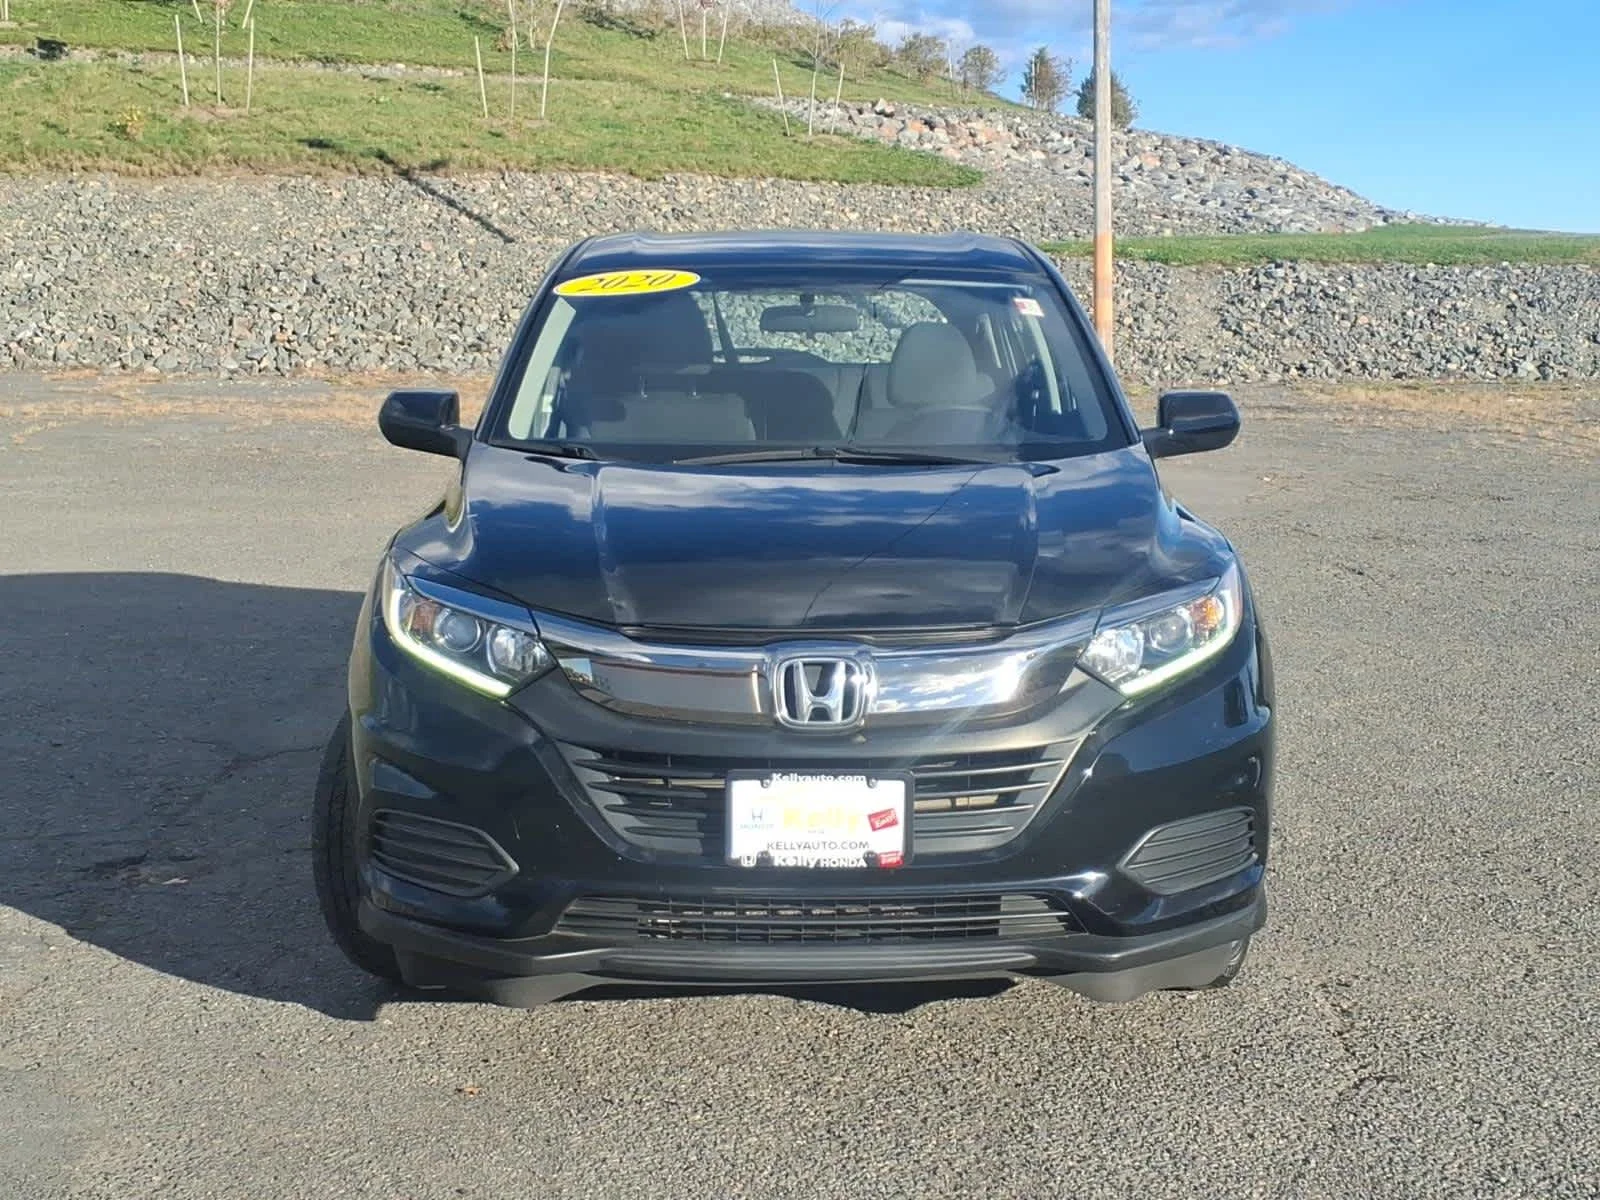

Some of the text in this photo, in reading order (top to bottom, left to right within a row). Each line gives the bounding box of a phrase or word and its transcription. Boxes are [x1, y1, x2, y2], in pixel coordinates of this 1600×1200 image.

[576, 274, 677, 292] 2020
[767, 841, 869, 851] KELLYAUTO.COM
[773, 854, 818, 868] Kelly
[820, 857, 867, 868] HONDA
